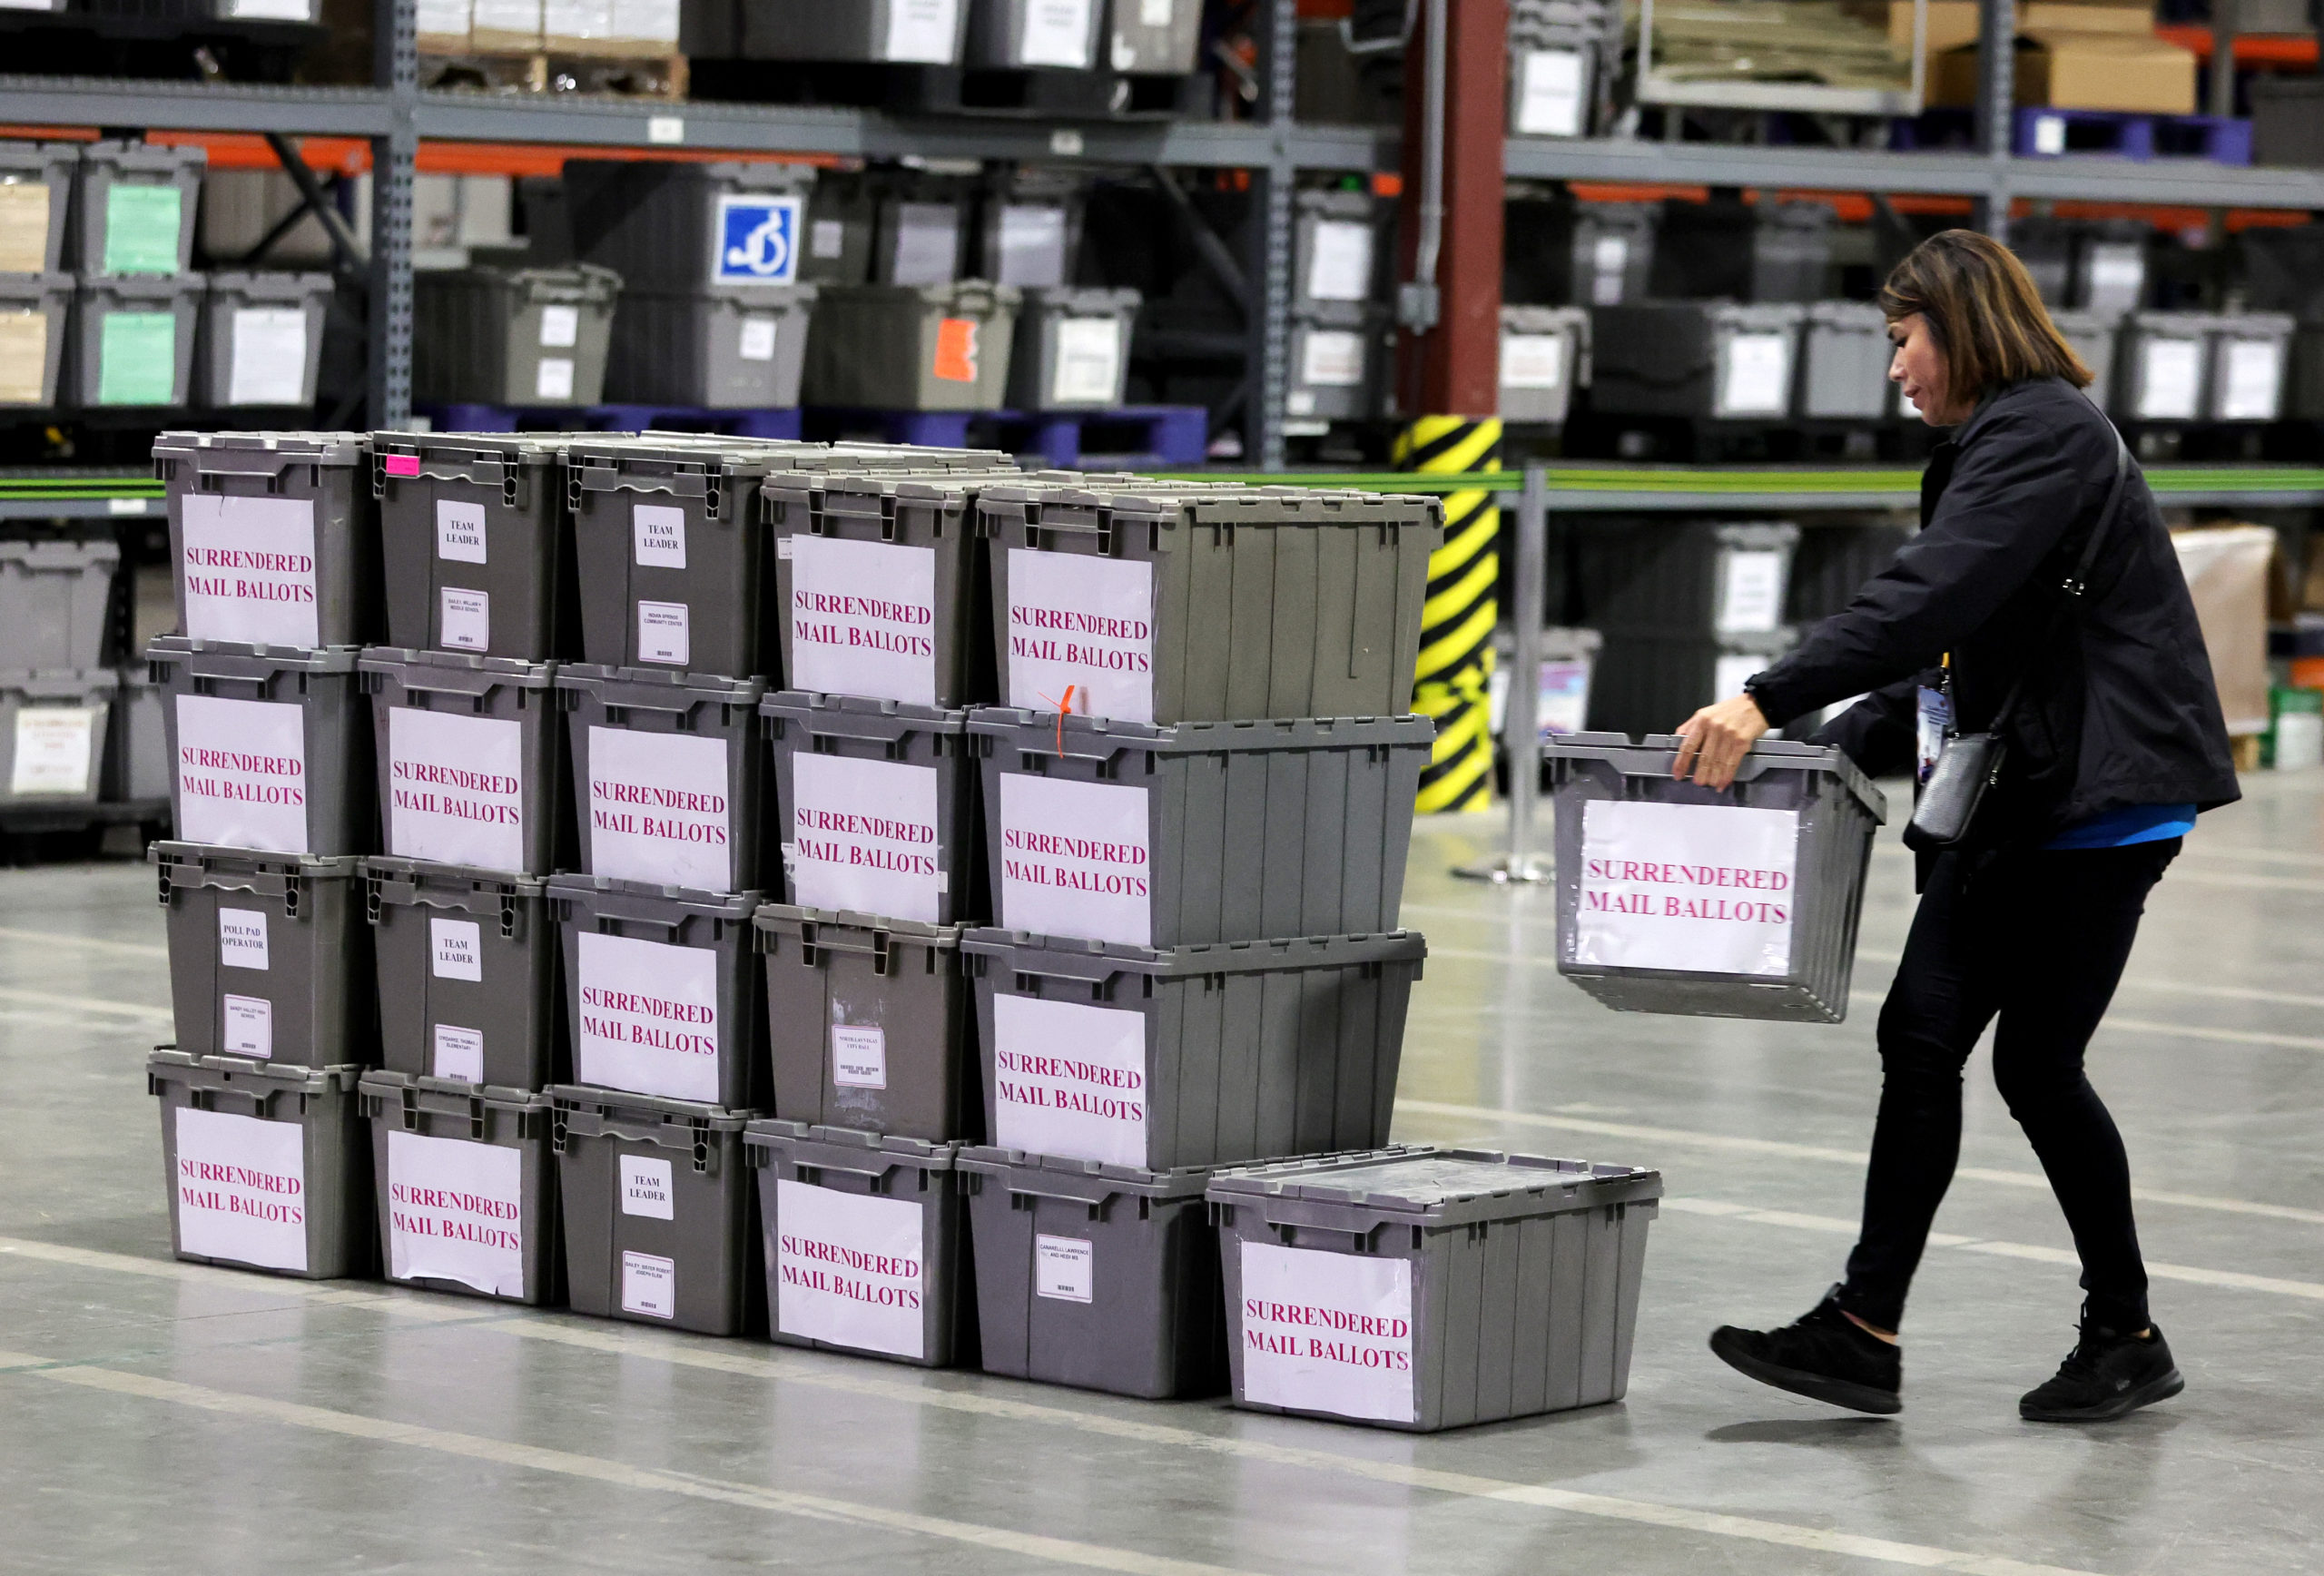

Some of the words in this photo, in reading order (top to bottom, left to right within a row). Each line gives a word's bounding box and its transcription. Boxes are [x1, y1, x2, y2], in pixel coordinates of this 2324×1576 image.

[446, 533, 479, 546] LEADER
[450, 519, 474, 531] TEAM
[648, 524, 673, 536] TEAM
[188, 547, 312, 573] SURRENDERED
[644, 538, 678, 549] LEADER
[188, 576, 231, 596] MAIL
[236, 580, 313, 603] BALLOTS
[796, 592, 931, 625] SURRENDERED
[1012, 606, 1147, 640] SURRENDERED
[797, 622, 842, 645] MAIL
[849, 626, 931, 655] BALLOTS
[1013, 636, 1061, 661] MAIL
[1067, 643, 1148, 672] BALLOTS
[182, 746, 302, 776] SURRENDERED
[394, 761, 518, 794] SURRENDERED
[183, 776, 220, 797] MAIL
[223, 780, 303, 806] BALLOTS
[396, 790, 439, 813] MAIL
[443, 796, 518, 825] BALLOTS
[594, 780, 725, 813] SURRENDERED
[595, 811, 638, 833] MAIL
[643, 816, 726, 844] BALLOTS
[798, 808, 934, 843] SURRENDERED
[798, 838, 843, 862] MAIL
[850, 845, 935, 875] BALLOTS
[1005, 828, 1147, 865] SURRENDERED
[1006, 860, 1051, 885] MAIL
[1055, 867, 1147, 897] BALLOTS
[1587, 859, 1788, 891] SURRENDERED
[1586, 891, 1656, 915] MAIL
[1663, 896, 1787, 924] BALLOTS
[222, 937, 264, 950] OPERATOR
[223, 924, 244, 935] POLL
[246, 927, 261, 937] PAD
[443, 938, 468, 951] TEAM
[439, 951, 473, 963] LEADER
[583, 988, 714, 1024] SURRENDERED
[584, 1016, 626, 1040] MAIL
[632, 1024, 714, 1055] BALLOTS
[1000, 1051, 1141, 1089] SURRENDERED
[1000, 1081, 1050, 1107] MAIL
[1055, 1088, 1143, 1120] BALLOTS
[181, 1160, 301, 1195] SURRENDERED
[634, 1175, 660, 1187] TEAM
[182, 1187, 225, 1211] MAIL
[230, 1194, 302, 1224] BALLOTS
[392, 1184, 518, 1220] SURRENDERED
[629, 1188, 665, 1201] LEADER
[393, 1212, 438, 1236] MAIL
[442, 1219, 519, 1250] BALLOTS
[782, 1235, 920, 1278] SURRENDERED
[783, 1265, 830, 1291] MAIL
[834, 1276, 920, 1309] BALLOTS
[1246, 1299, 1408, 1338] SURRENDERED
[1247, 1329, 1303, 1356] MAIL
[1310, 1338, 1409, 1372] BALLOTS
